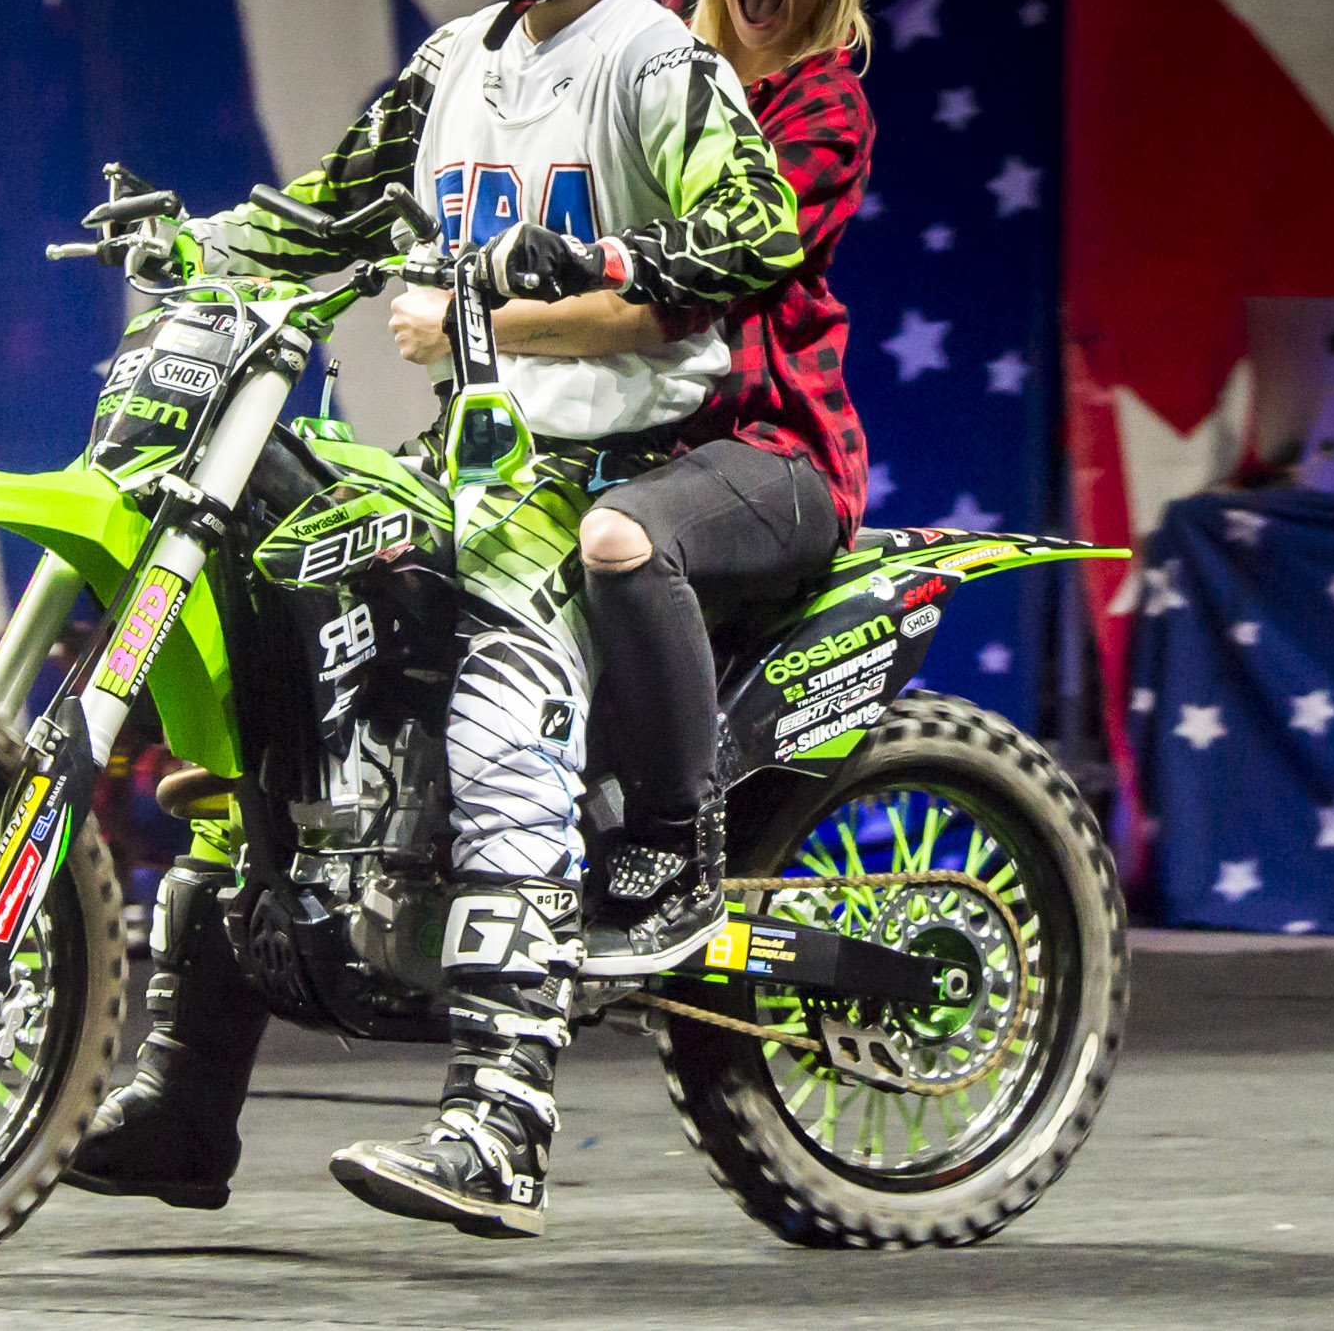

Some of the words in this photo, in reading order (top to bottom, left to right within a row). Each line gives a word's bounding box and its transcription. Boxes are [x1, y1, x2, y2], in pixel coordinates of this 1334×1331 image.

[434, 162, 603, 256] FRA
[159, 362, 211, 388] SHOEI
[290, 507, 350, 538] Kawasaki
[298, 509, 412, 583] BUD
[941, 544, 1012, 571] GoldenTyre
[902, 576, 947, 609] SKIL
[907, 611, 935, 633] SHOEI
[129, 590, 187, 697] SUSPENSION
[765, 614, 896, 685] 69slam
[796, 682, 844, 709] TRACTION
[846, 675, 858, 688] IN
[860, 660, 894, 679] ACTION
[807, 638, 899, 695] STOMPGRIP
[796, 701, 881, 754] Silkolene
[46, 774, 68, 808] BRAKES
[553, 892, 573, 911] 12
[441, 895, 523, 969] G
[511, 1174, 534, 1204] G
